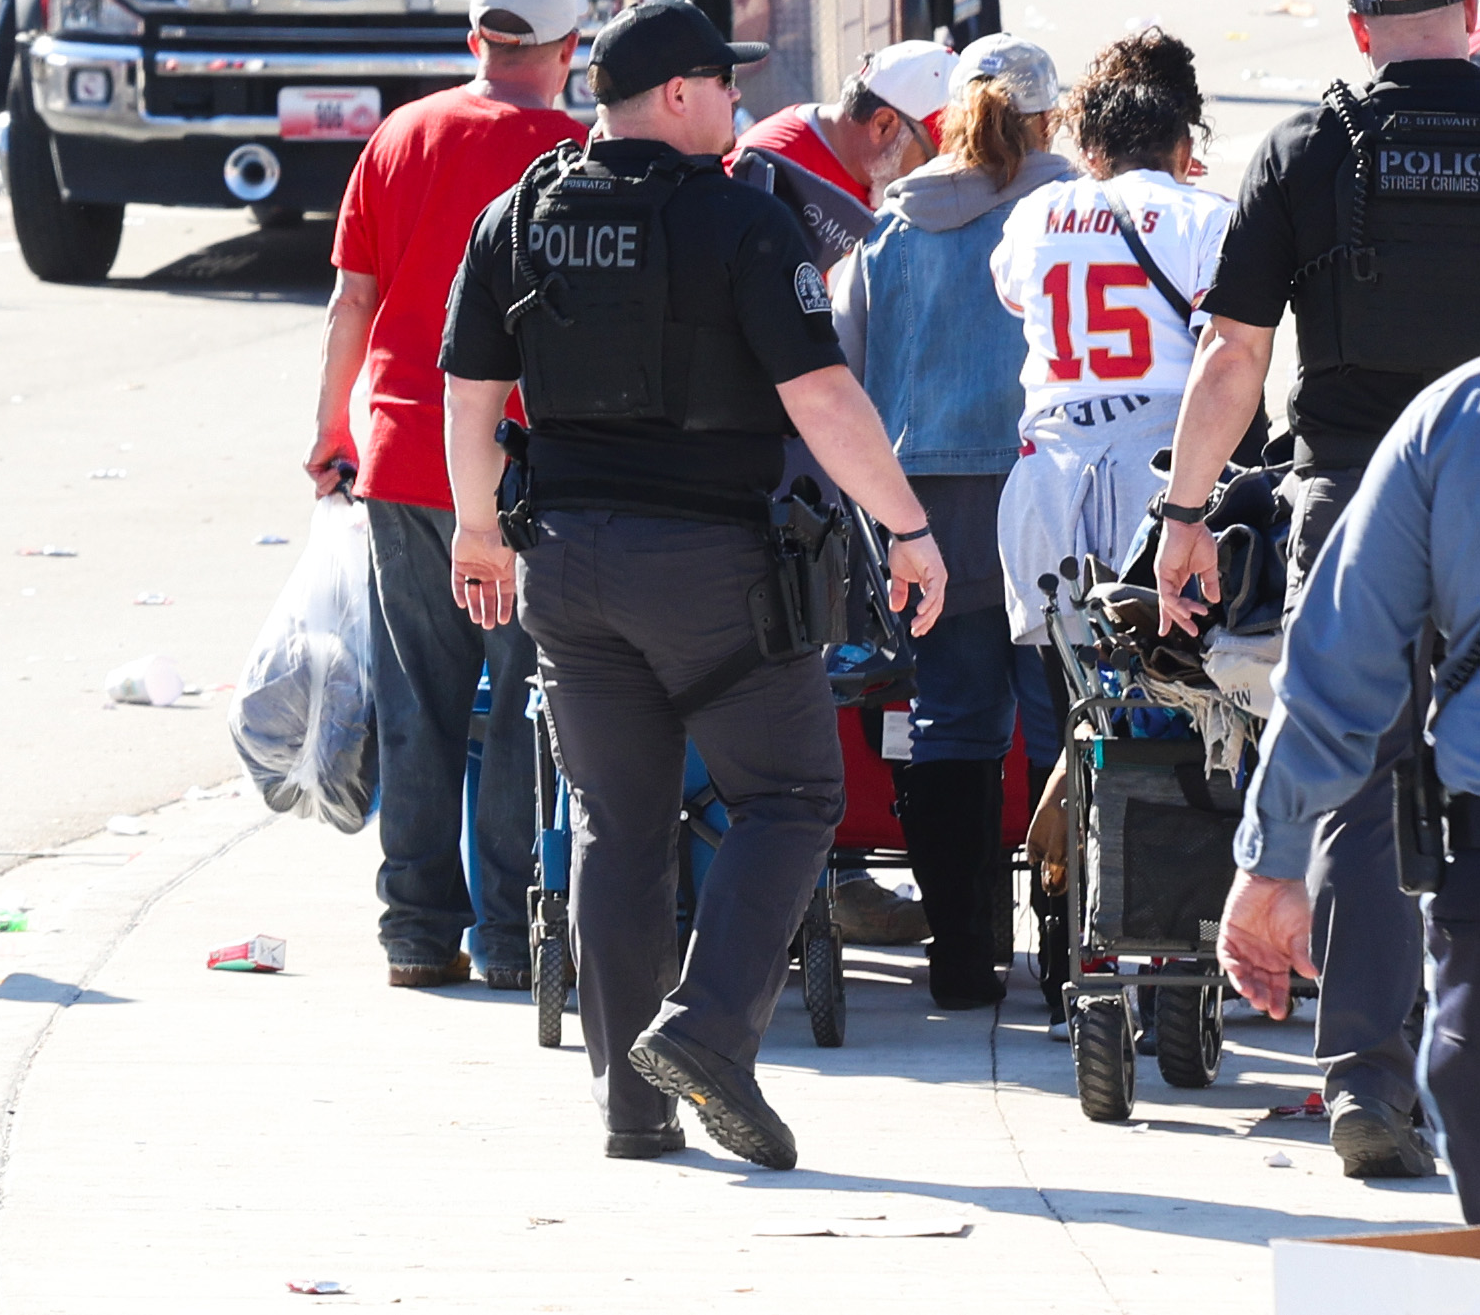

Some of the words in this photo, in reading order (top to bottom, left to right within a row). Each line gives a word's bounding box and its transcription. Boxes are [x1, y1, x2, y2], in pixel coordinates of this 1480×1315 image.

[1415, 116, 1479, 128] STEWART
[1379, 150, 1480, 176] POLIC
[1380, 175, 1428, 191] STREET
[1431, 176, 1480, 192] CRIMES
[1045, 208, 1160, 235] MAHOS
[528, 224, 638, 268] POLICE
[1041, 261, 1154, 382] 15
